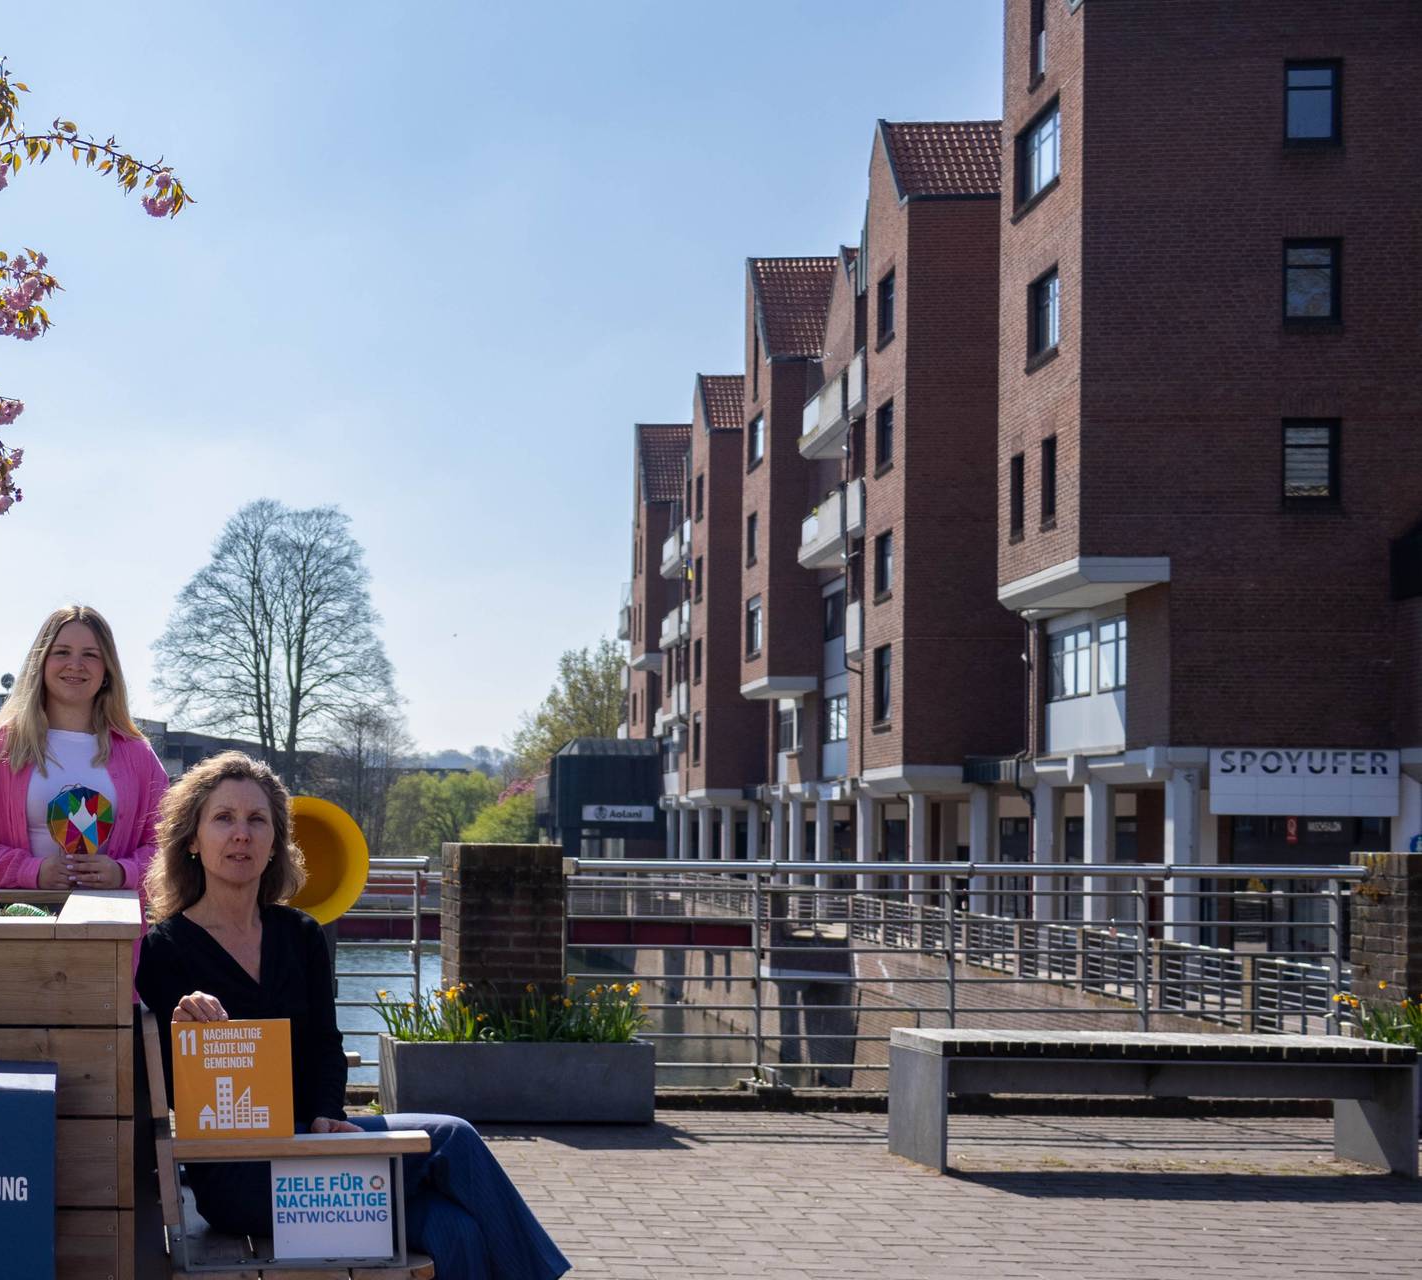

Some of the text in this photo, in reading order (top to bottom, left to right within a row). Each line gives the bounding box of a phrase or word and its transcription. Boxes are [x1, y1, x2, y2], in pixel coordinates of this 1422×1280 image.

[1220, 750, 1389, 775] SPOYUFER
[178, 1028, 262, 1056] 11 NACHHALTIGE
[203, 1042, 256, 1055] STÄDTE UND
[204, 1056, 254, 1069] GEMEINDEN
[276, 1173, 363, 1192] ZIELE FÜR
[276, 1193, 387, 1208] NACHHALTIGE
[277, 1210, 388, 1224] ENTWICKLUNG
